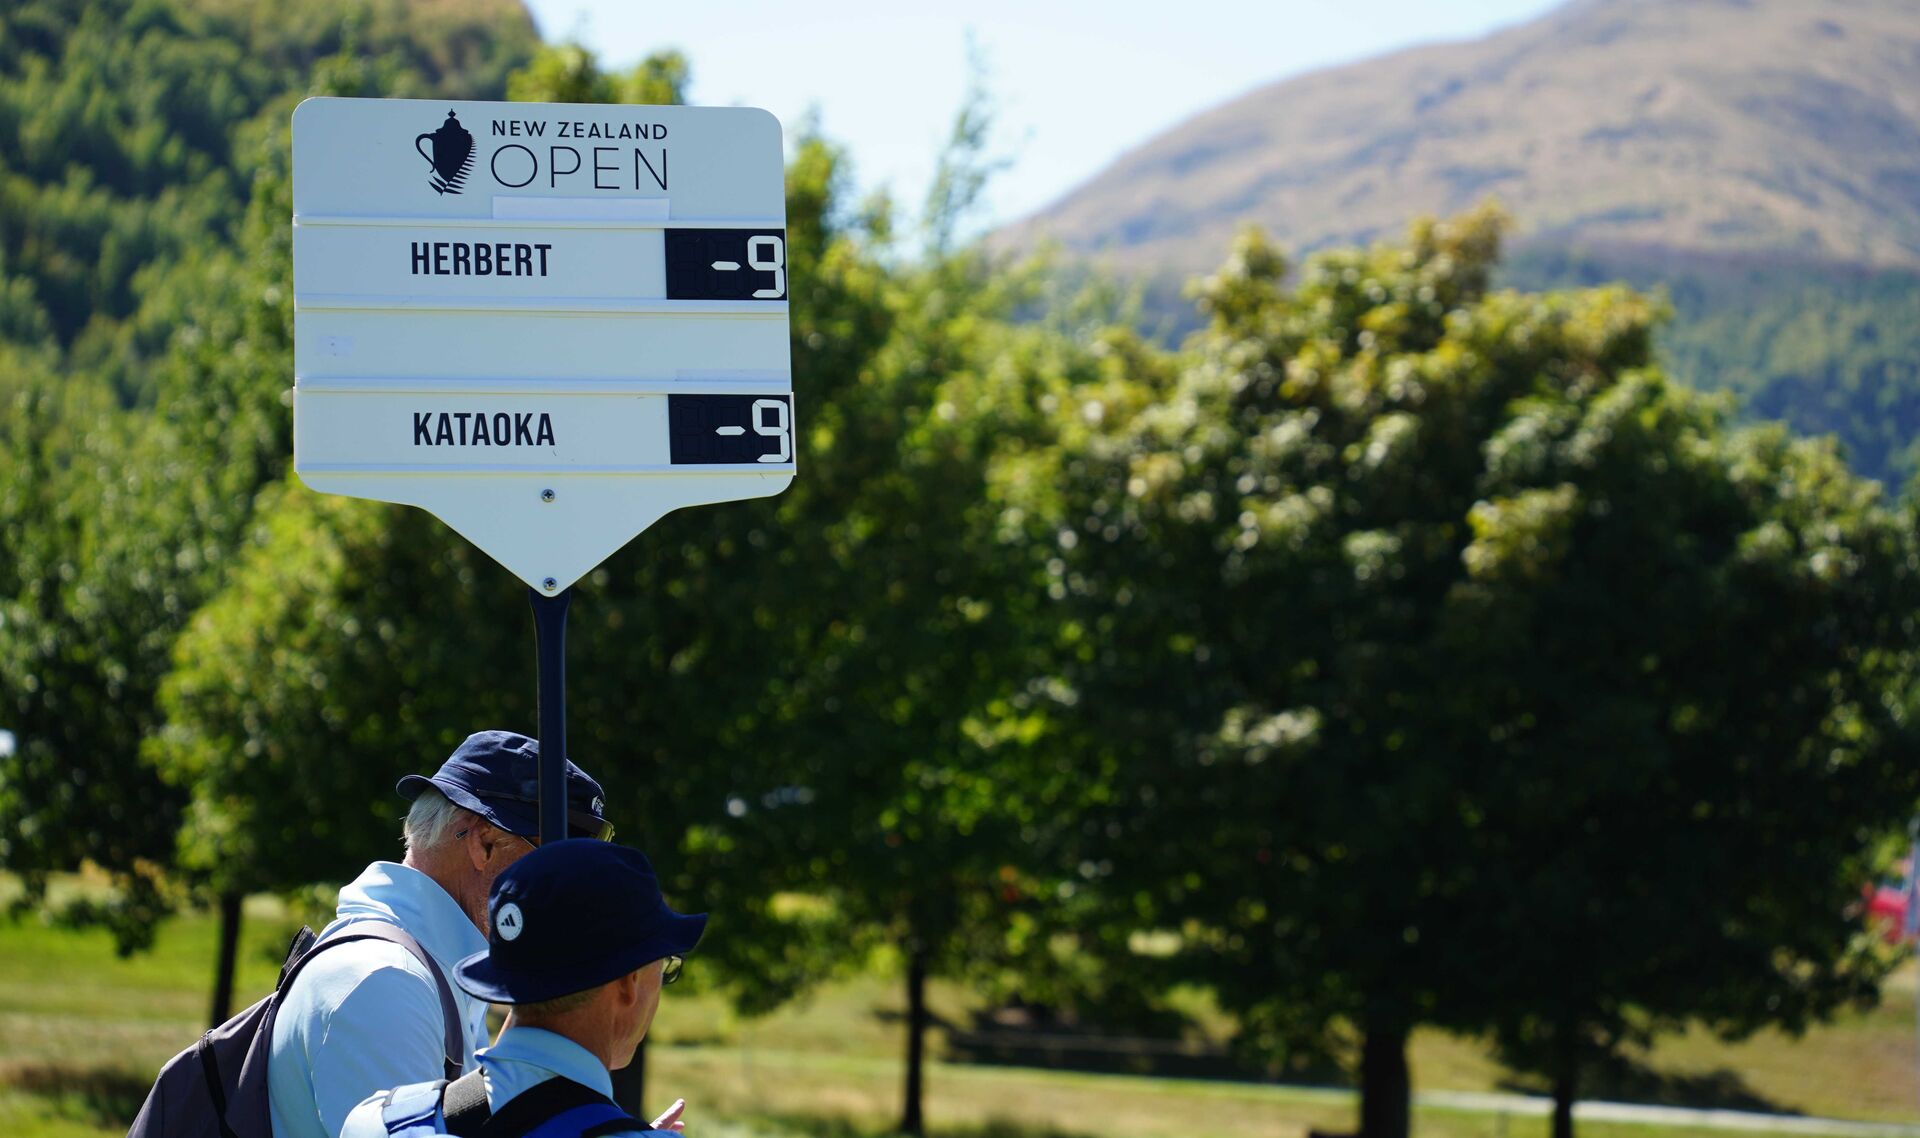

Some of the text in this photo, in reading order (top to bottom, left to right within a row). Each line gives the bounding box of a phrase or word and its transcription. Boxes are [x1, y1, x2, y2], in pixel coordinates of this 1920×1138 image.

[493, 120, 668, 140] NEW ZEALAND
[491, 144, 668, 190] OPEN
[411, 242, 552, 277] HERBERT
[711, 235, 785, 298] -9
[413, 412, 556, 447] KATAOKA
[715, 399, 790, 463] -9
